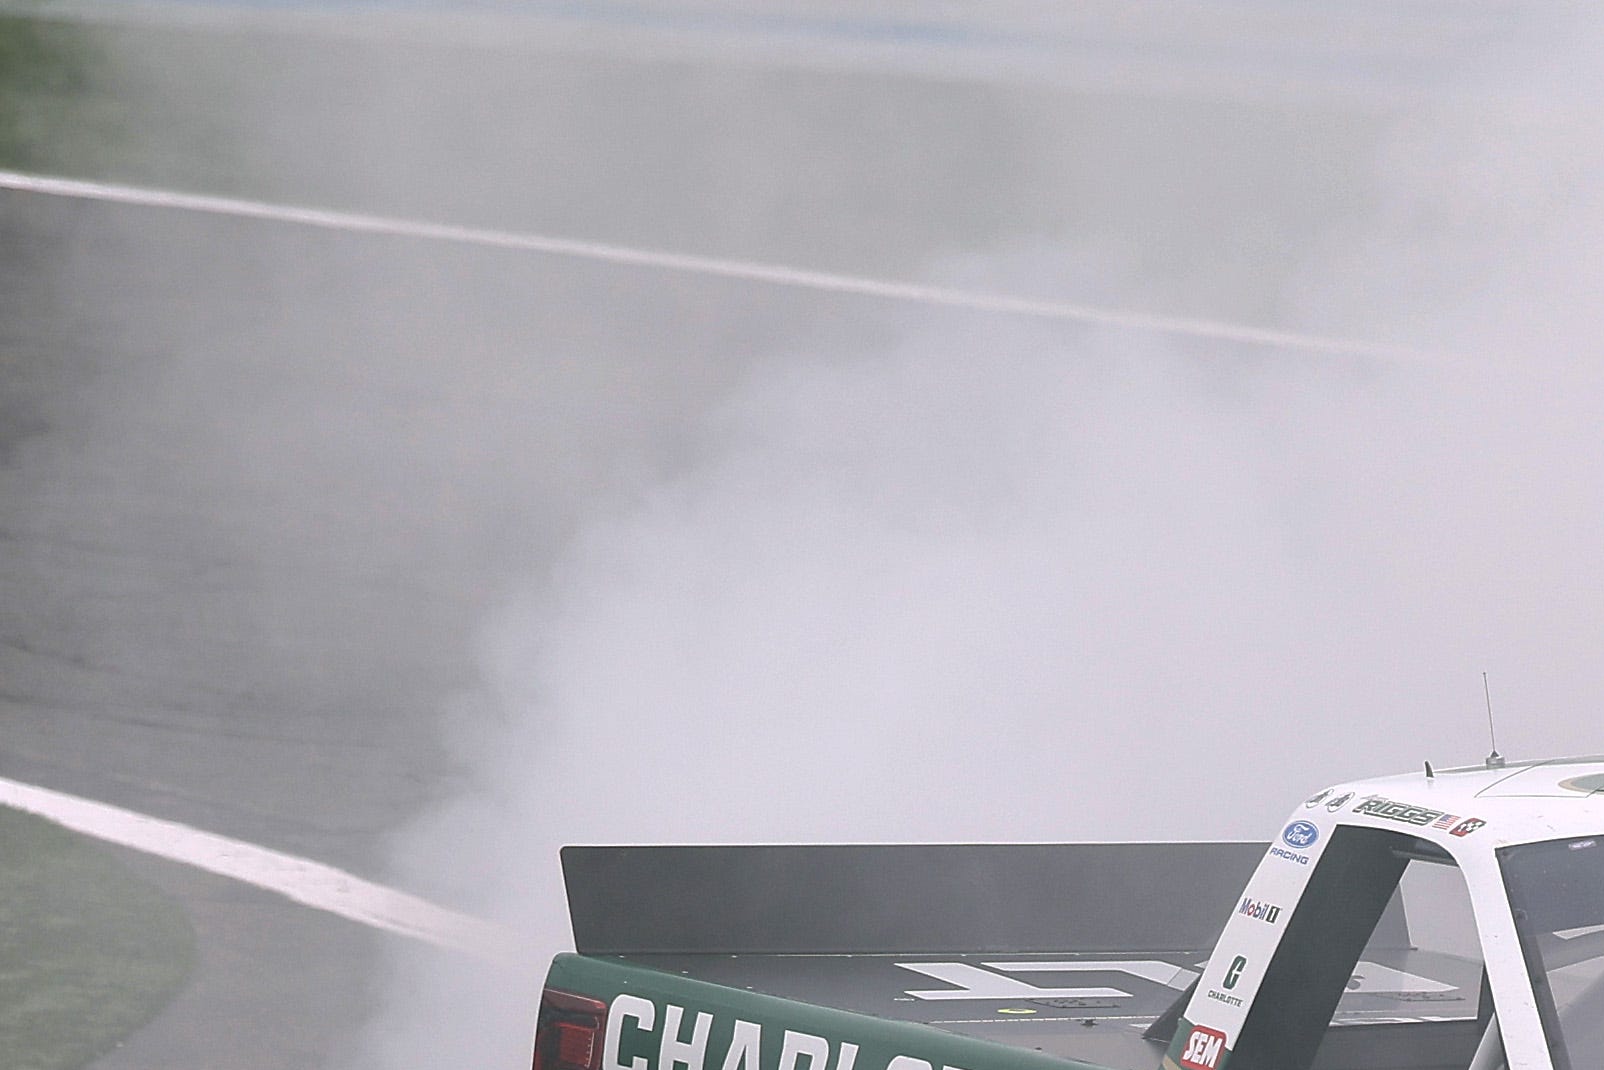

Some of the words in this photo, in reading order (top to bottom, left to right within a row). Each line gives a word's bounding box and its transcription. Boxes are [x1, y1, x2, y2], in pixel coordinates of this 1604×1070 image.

[1352, 799, 1445, 826] RIGGS
[1286, 824, 1316, 846] Ford
[1269, 847, 1309, 865] RACING
[1239, 898, 1267, 919] Mobil
[1208, 990, 1242, 1007] CHARLOTTE
[1183, 1032, 1223, 1068] SEM
